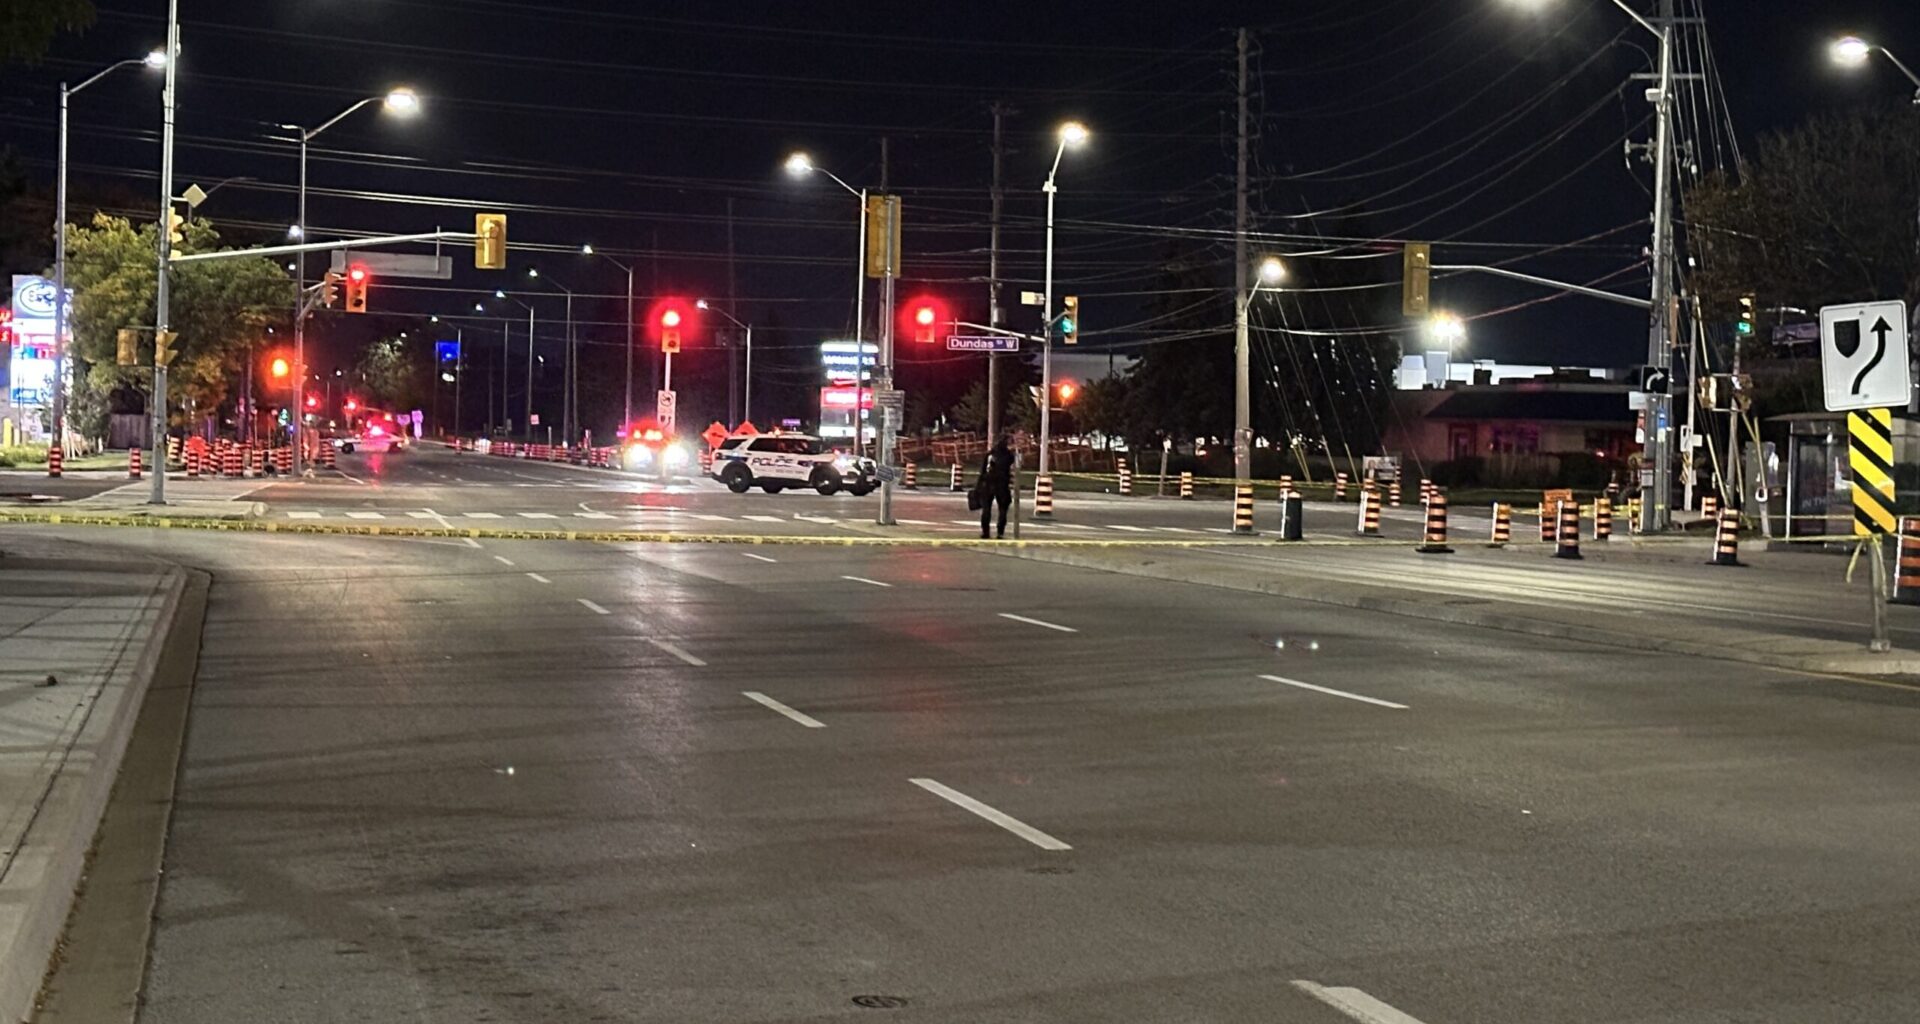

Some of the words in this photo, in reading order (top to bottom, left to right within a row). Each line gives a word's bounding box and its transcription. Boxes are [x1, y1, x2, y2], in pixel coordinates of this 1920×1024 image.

[950, 338, 994, 349] Dundas
[1005, 339, 1015, 349] W
[751, 457, 794, 467] POLICE
